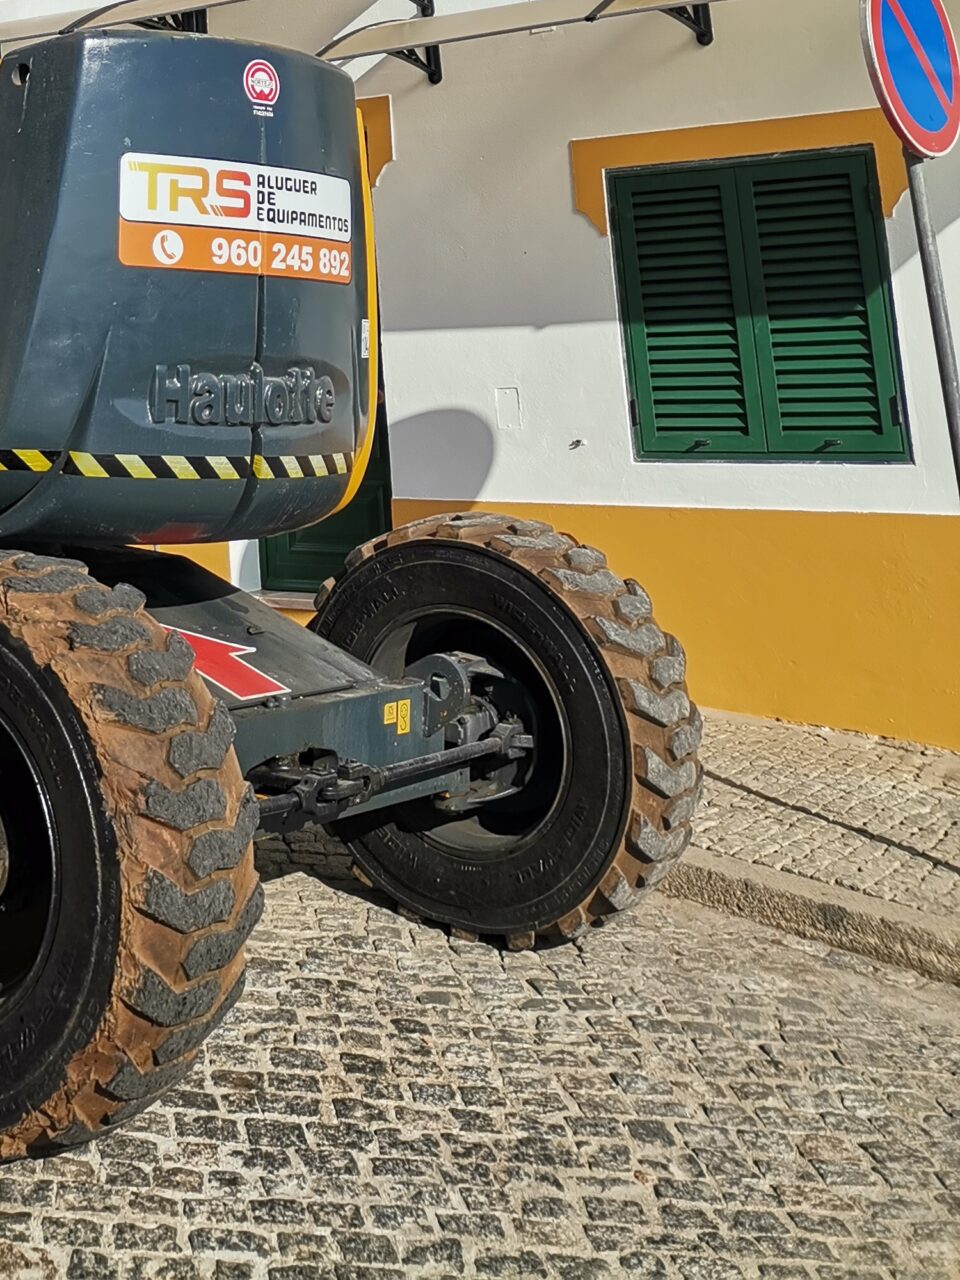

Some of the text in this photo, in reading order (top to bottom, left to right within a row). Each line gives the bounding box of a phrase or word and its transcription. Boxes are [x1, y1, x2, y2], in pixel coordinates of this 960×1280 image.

[128, 161, 252, 218] TRS
[256, 173, 317, 196] ALUGUER
[256, 190, 277, 206] DE
[256, 206, 349, 233] EQUIPAMENTOS
[211, 236, 350, 277] 960 245 892
[151, 362, 336, 426] Haulotte
